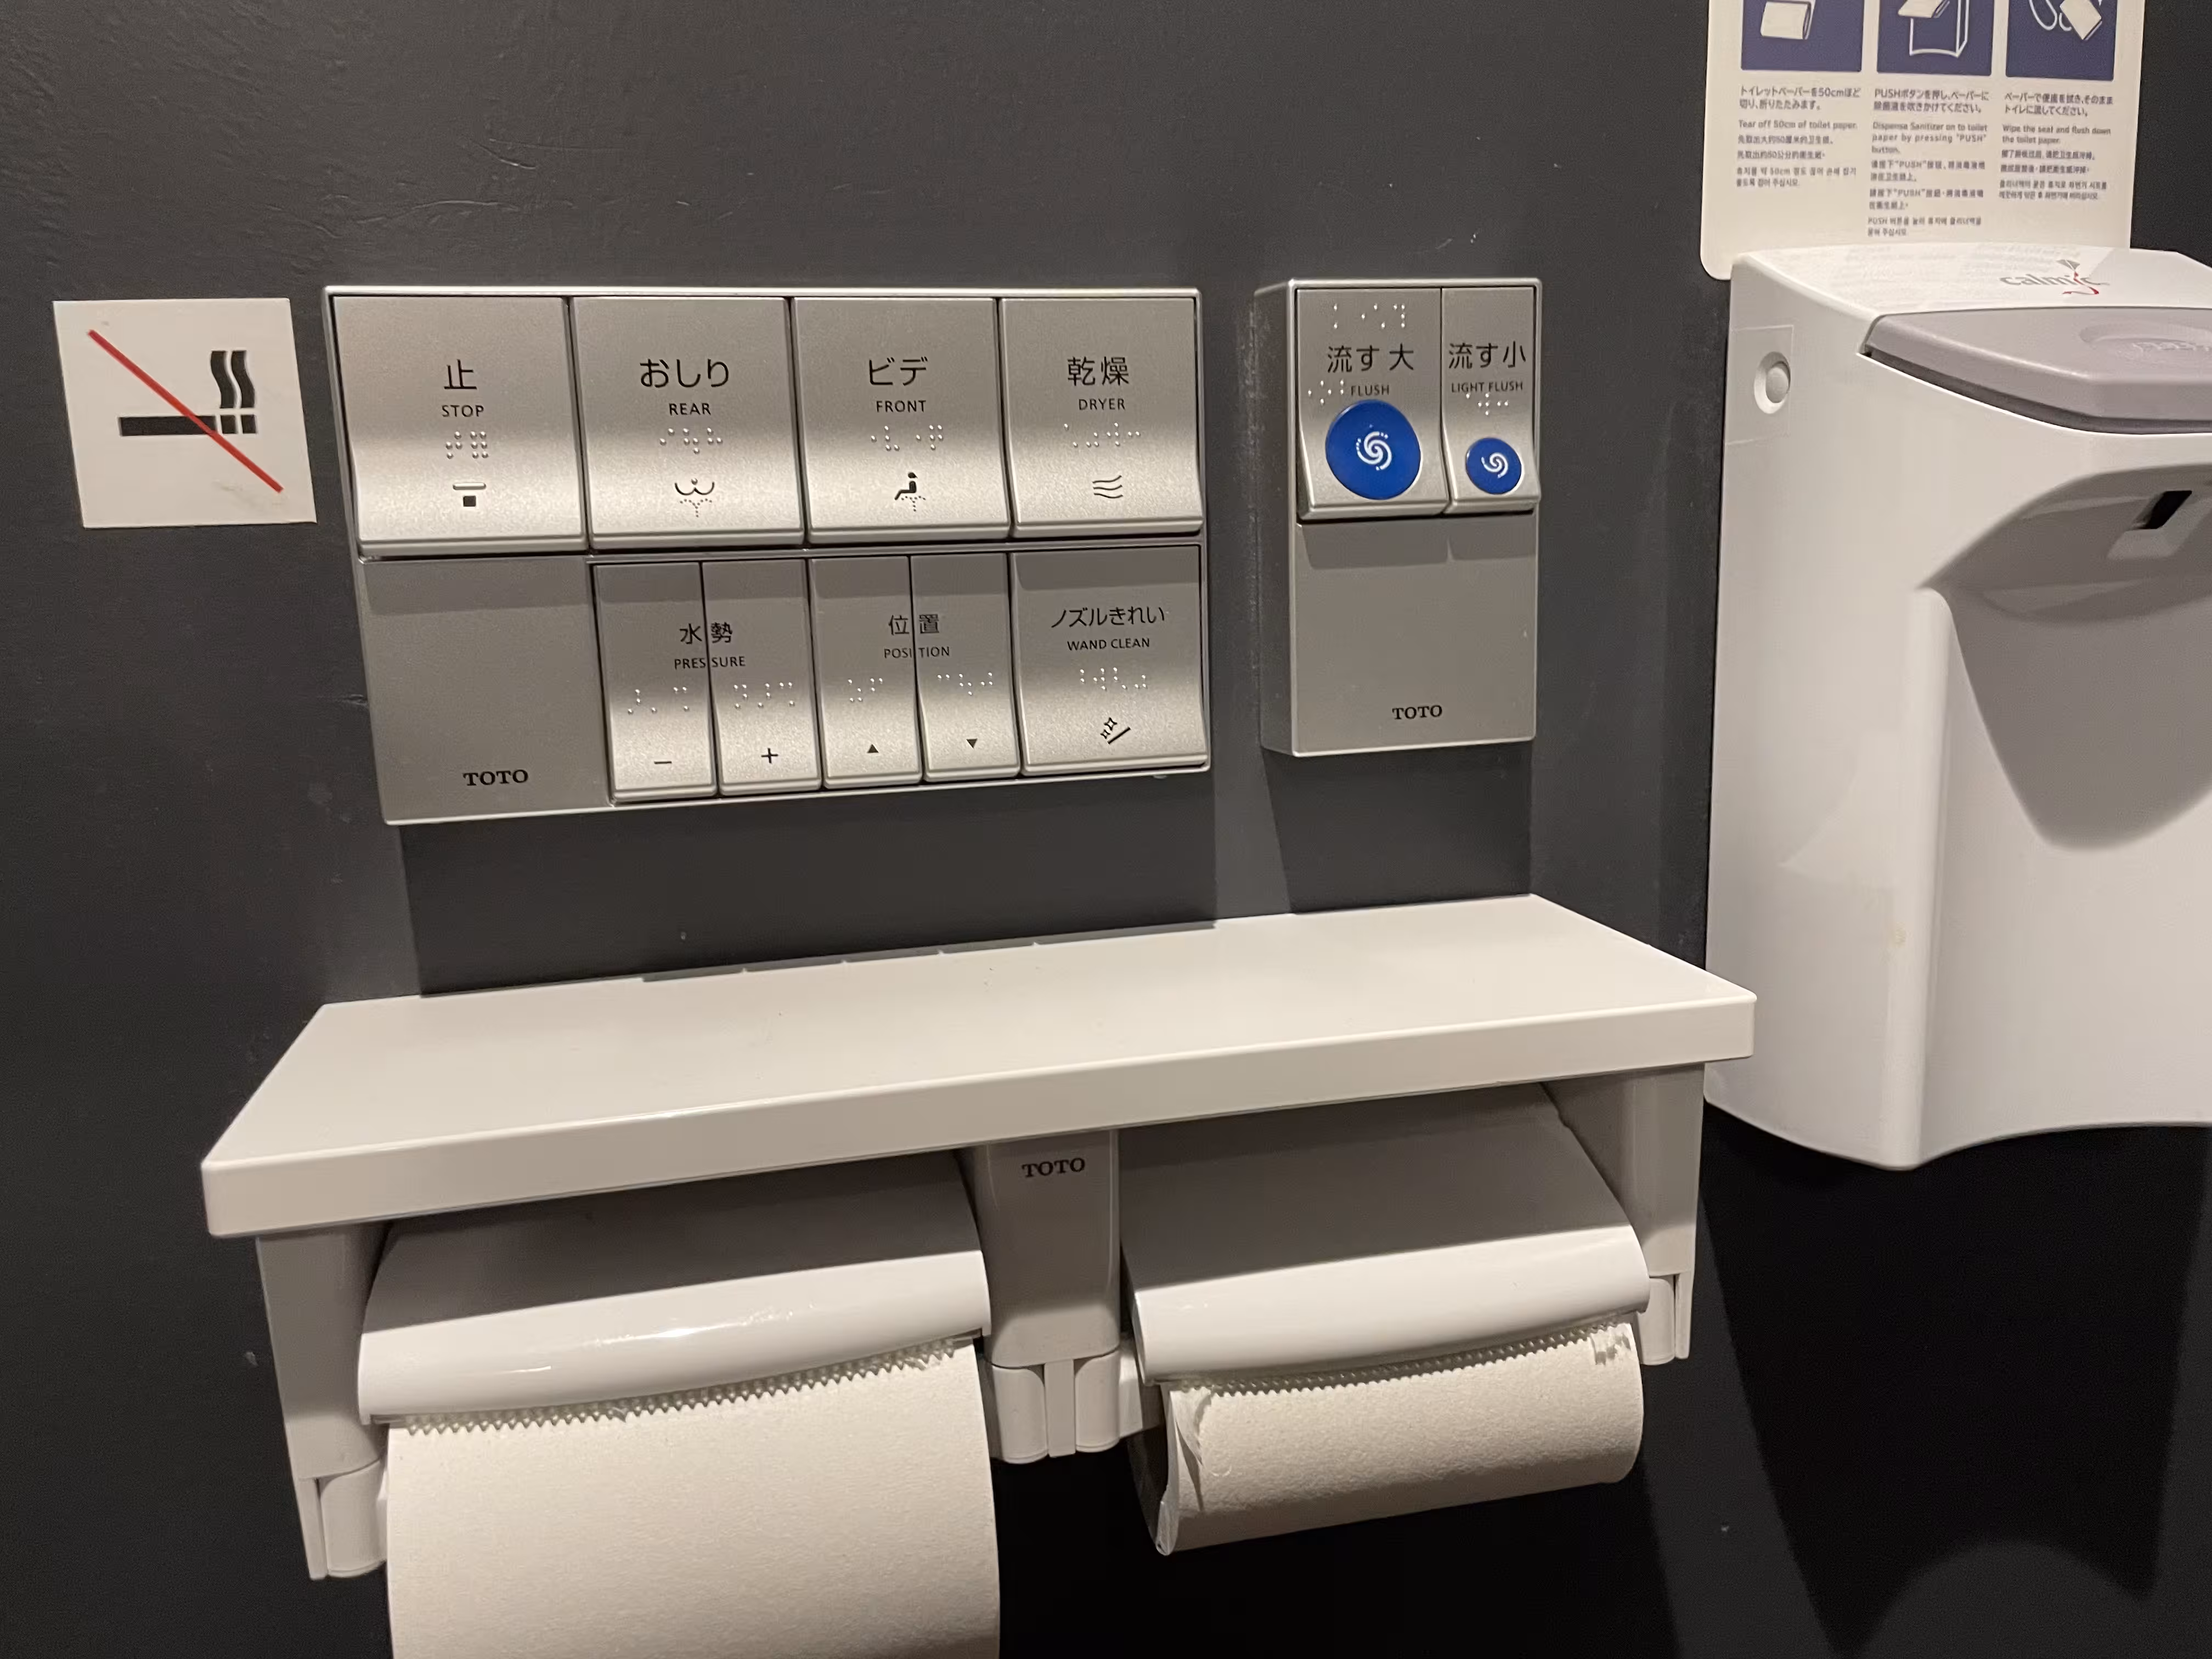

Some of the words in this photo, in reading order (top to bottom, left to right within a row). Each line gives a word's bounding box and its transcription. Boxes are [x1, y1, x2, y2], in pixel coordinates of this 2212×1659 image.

[1739, 120, 1756, 128] Tear
[1873, 121, 1908, 131] Dispense
[1910, 122, 1944, 130] Sanitizer
[1967, 123, 1988, 132] toilet
[2002, 123, 2021, 132] Wipe
[2023, 125, 2035, 133] the
[2072, 126, 2090, 134] flush
[2092, 127, 2112, 135] down
[1872, 134, 1897, 142] paper
[1901, 133, 1912, 143] by
[1915, 133, 1953, 143] pressing
[1449, 341, 1526, 369] 流す小
[444, 359, 477, 390] 止
[640, 359, 729, 388] おしり
[869, 357, 928, 386] ビデ
[1068, 357, 1128, 386] 乾燥
[1351, 385, 1389, 396] FLUSH
[1452, 382, 1484, 392] LIGHT
[1489, 381, 1522, 391] FLUSH
[669, 403, 710, 415] REAR
[877, 400, 926, 413] FRONT
[1079, 398, 1125, 410] DRYER
[442, 405, 483, 417] STOP
[1051, 606, 1164, 628] ノズルきれい
[1068, 640, 1106, 651] WAND
[1111, 638, 1149, 648] CLEAN
[1392, 705, 1442, 719] TOTO
[463, 770, 528, 786] TOTO
[1022, 1158, 1085, 1177] TOTO
